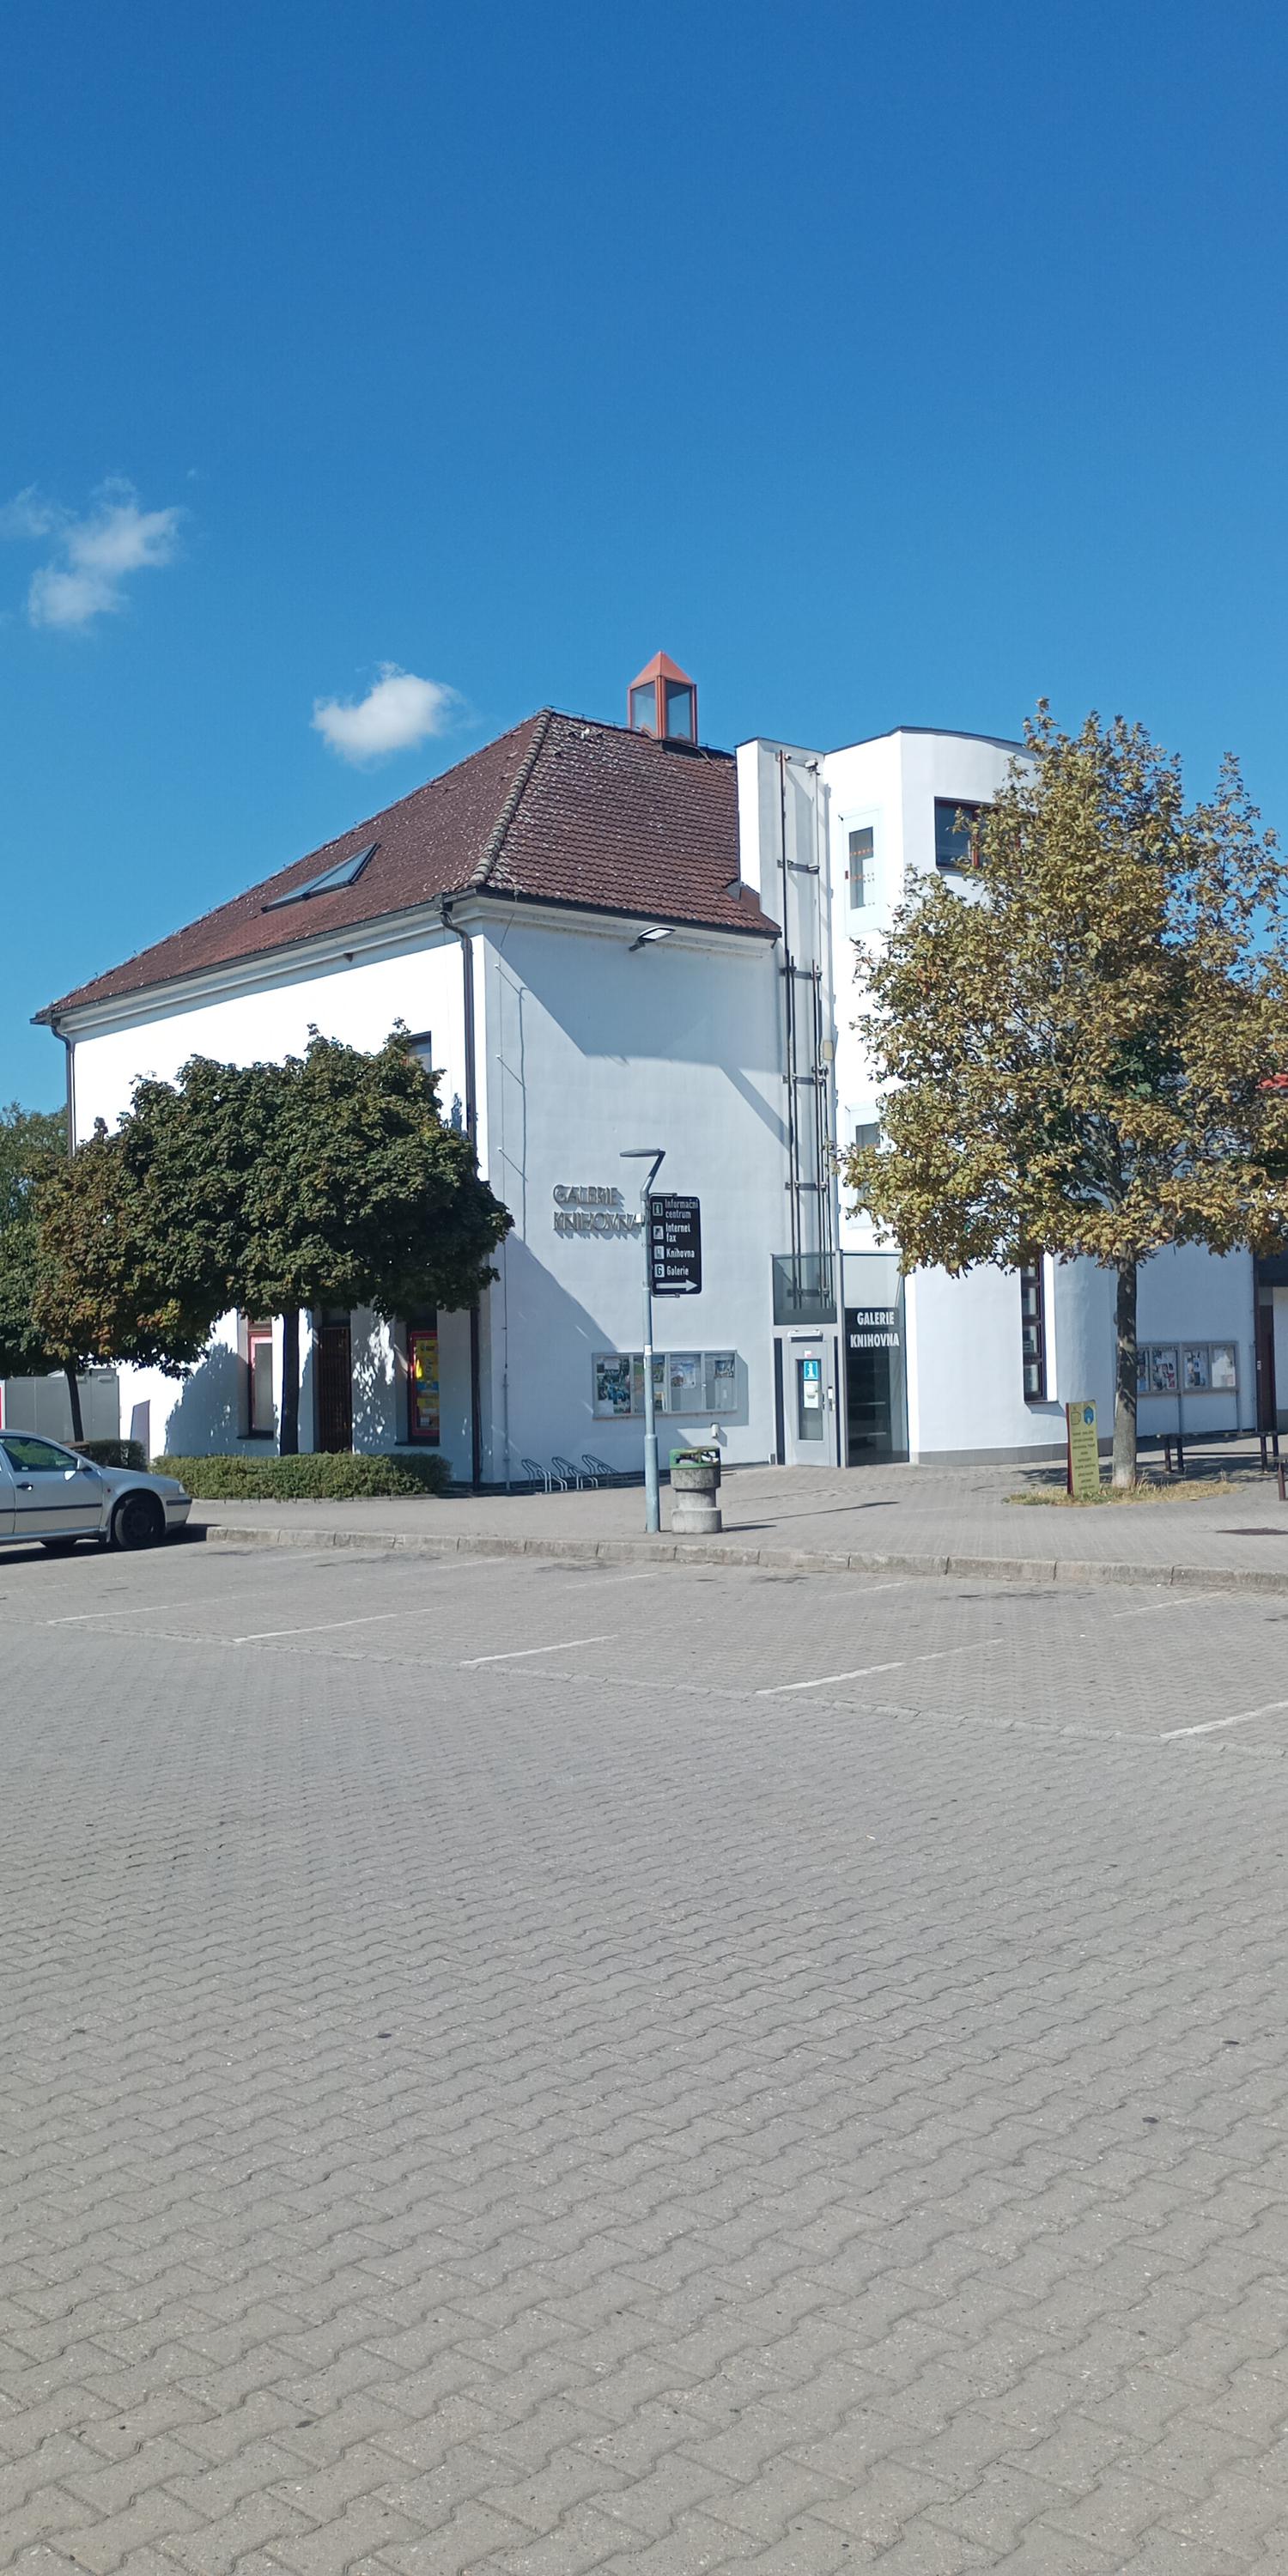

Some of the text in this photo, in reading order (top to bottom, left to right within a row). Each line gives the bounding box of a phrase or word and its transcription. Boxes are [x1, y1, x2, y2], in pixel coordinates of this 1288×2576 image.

[553, 1184, 619, 1205] GALERIE
[665, 1198, 698, 1209] Informační
[665, 1210, 691, 1219] centrum
[665, 1222, 691, 1232] Internet
[666, 1232, 677, 1242] fax
[666, 1248, 696, 1258] Knihovna
[657, 1266, 689, 1276] G Galerie
[857, 1311, 895, 1326] GALERIE
[850, 1333, 900, 1348] KNIHOVNA
